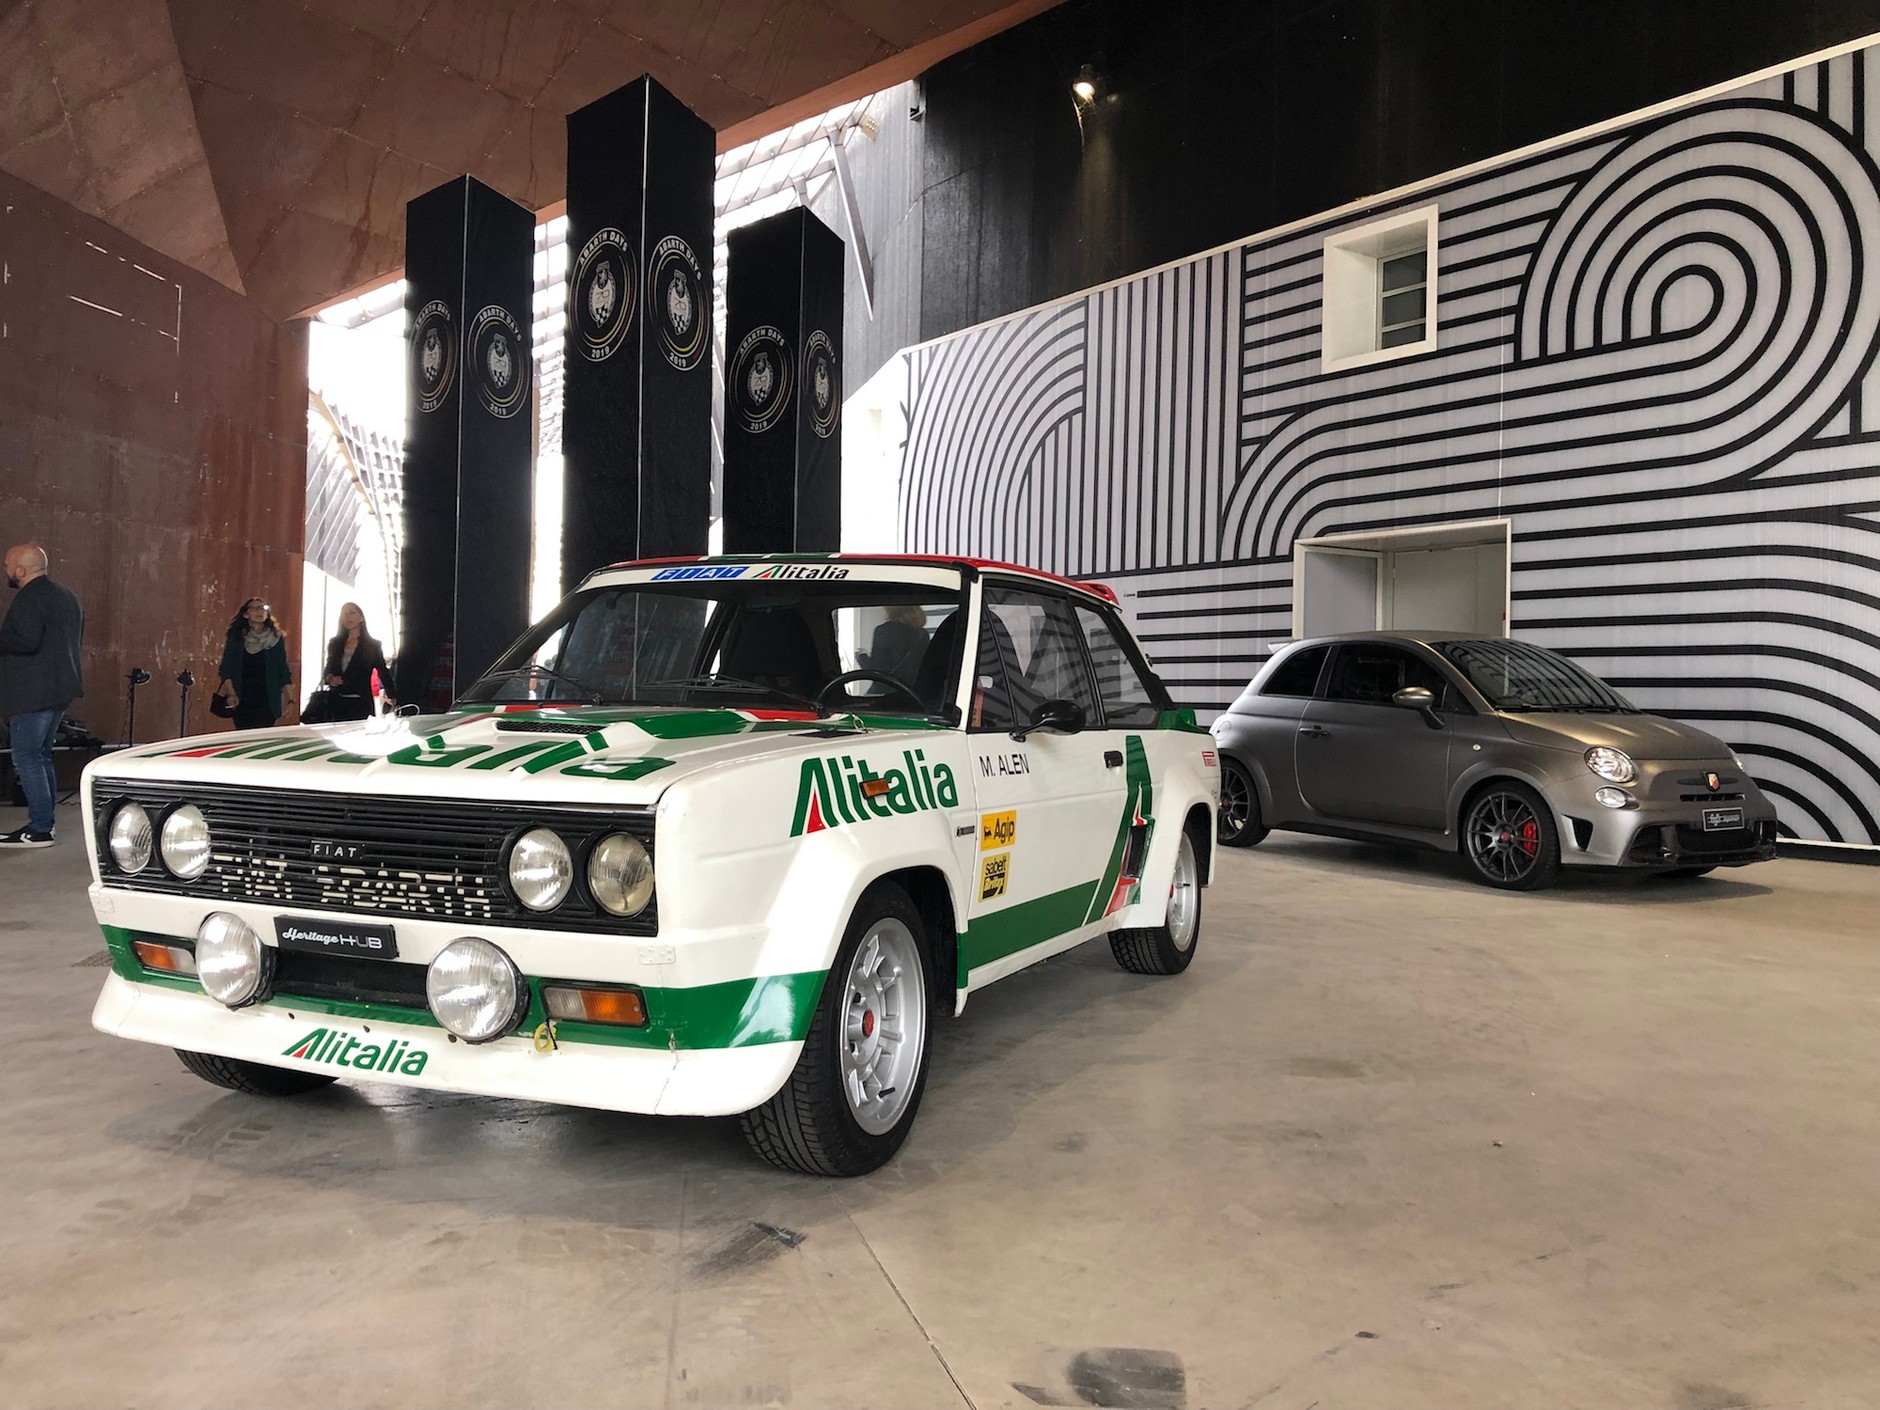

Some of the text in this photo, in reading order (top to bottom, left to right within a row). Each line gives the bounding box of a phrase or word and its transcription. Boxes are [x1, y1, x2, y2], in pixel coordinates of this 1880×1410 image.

[579, 232, 629, 266] ABARTH DAYS
[659, 239, 702, 281] ABARTH DAYS
[480, 308, 522, 342] ABARTH DAYS
[591, 346, 610, 358] 2019
[740, 329, 785, 354] ABARTH DAYS
[669, 352, 687, 367] 2019
[423, 400, 437, 410] 2019
[490, 403, 507, 415] 2019
[751, 420, 768, 431] 2019
[652, 567, 748, 580] FIAT
[753, 565, 850, 579] Alitalia
[979, 753, 1030, 777] M. ALEN
[790, 748, 959, 838] Alitalia
[994, 816, 1015, 844] Agip
[313, 844, 357, 858] FIAT
[985, 855, 1007, 876] sabelt
[213, 855, 492, 918] FIAT ABARTH
[282, 927, 383, 949] Heritage HUB
[281, 1027, 429, 1076] Alitalia
